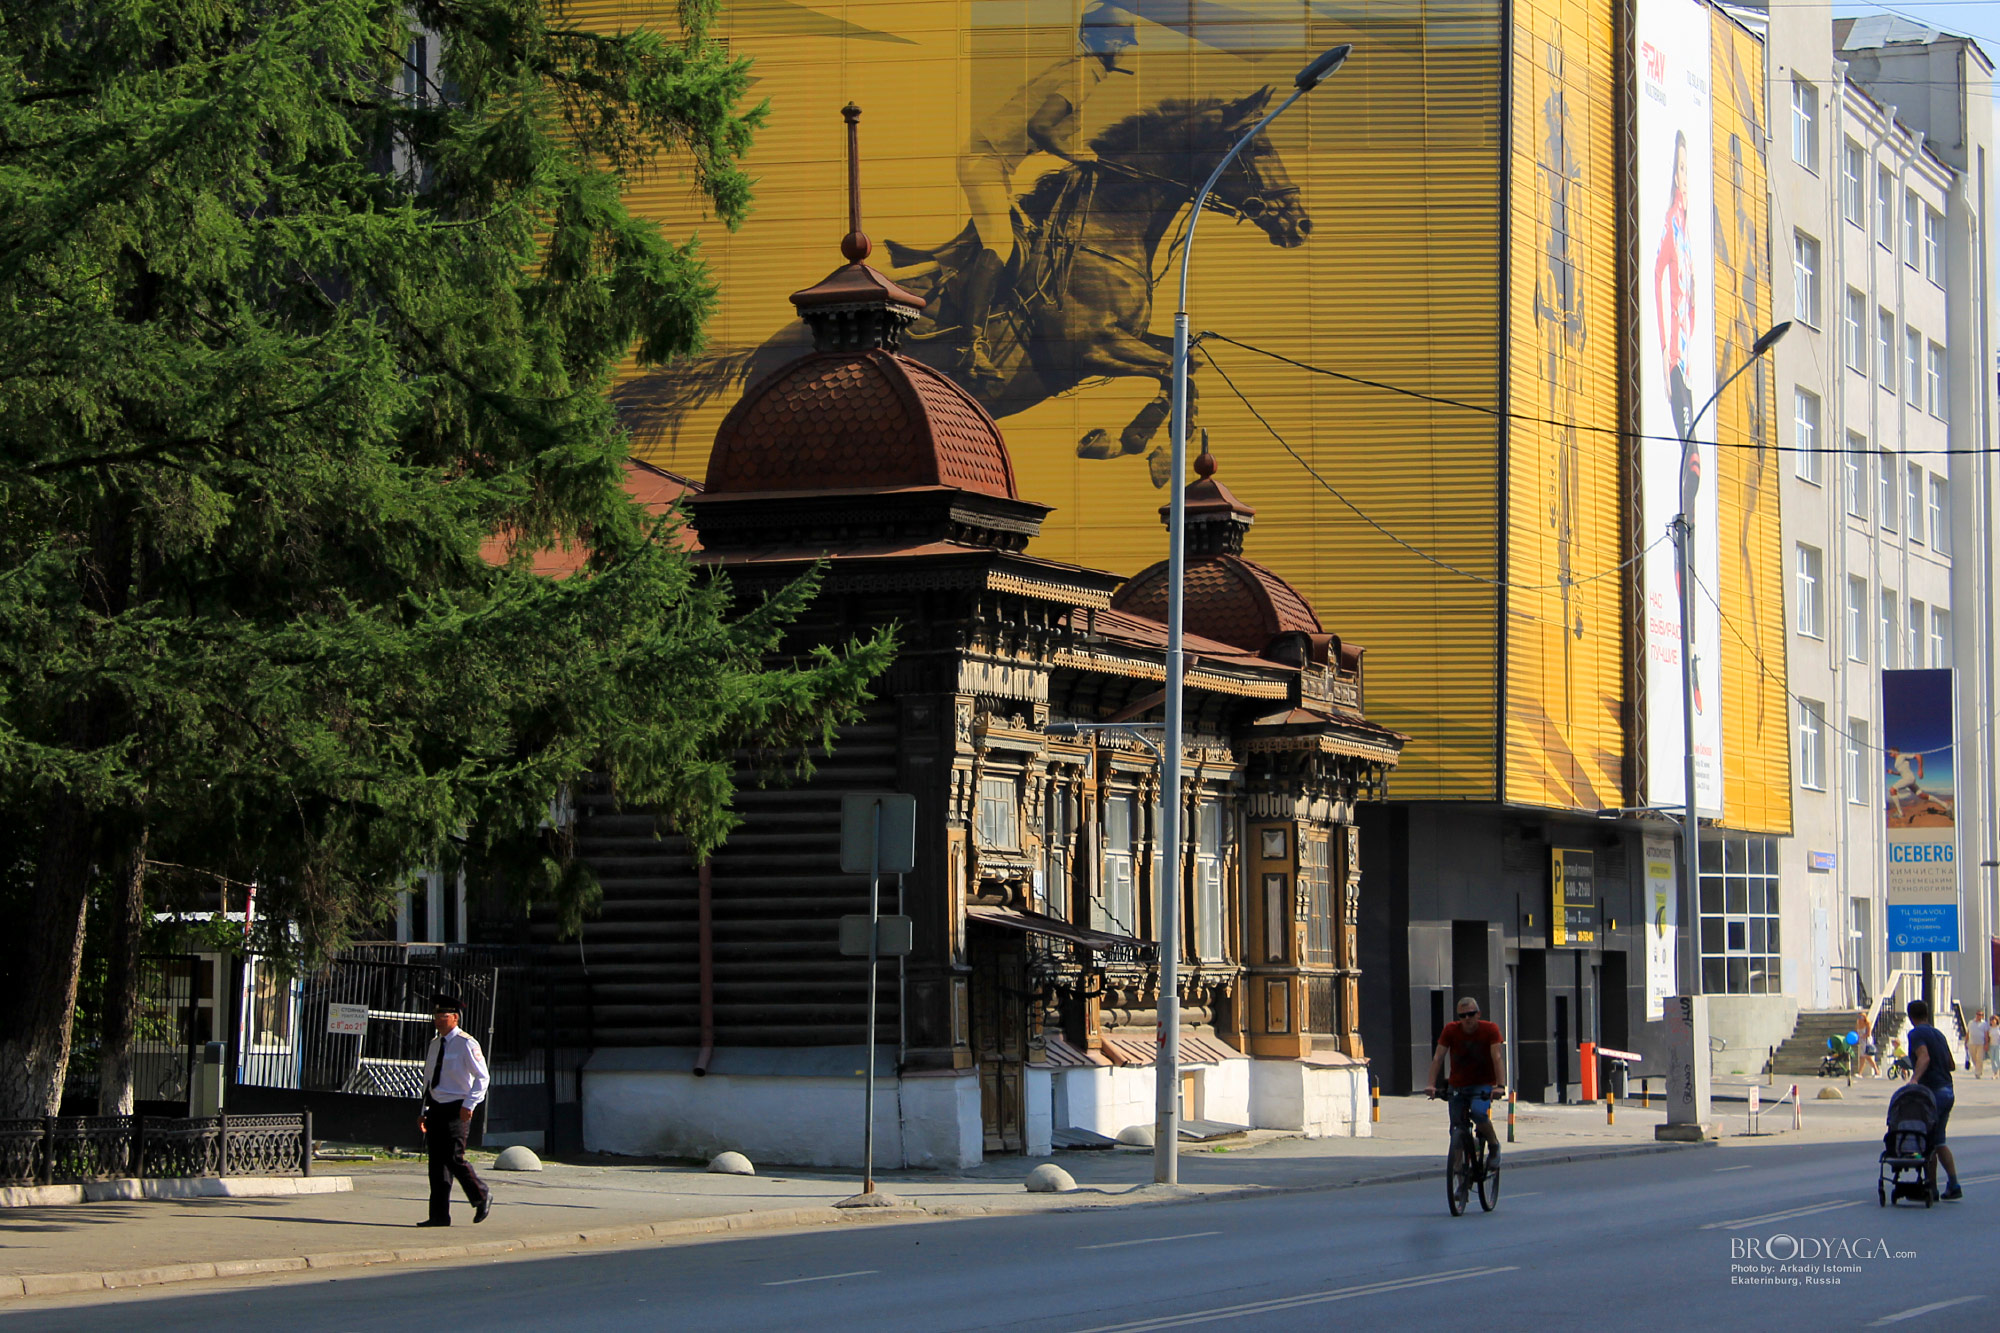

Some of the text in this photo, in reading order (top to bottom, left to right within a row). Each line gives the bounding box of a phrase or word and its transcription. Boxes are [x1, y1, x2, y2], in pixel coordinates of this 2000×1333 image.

[1641, 41, 1665, 85] RAY
[1889, 842, 1953, 862] ICEBERG
[1890, 867, 1954, 876] ХИМЧИСТКА
[1906, 877, 1952, 885] НЕМЕЦКИМ
[1910, 936, 1951, 944] 201-47-47
